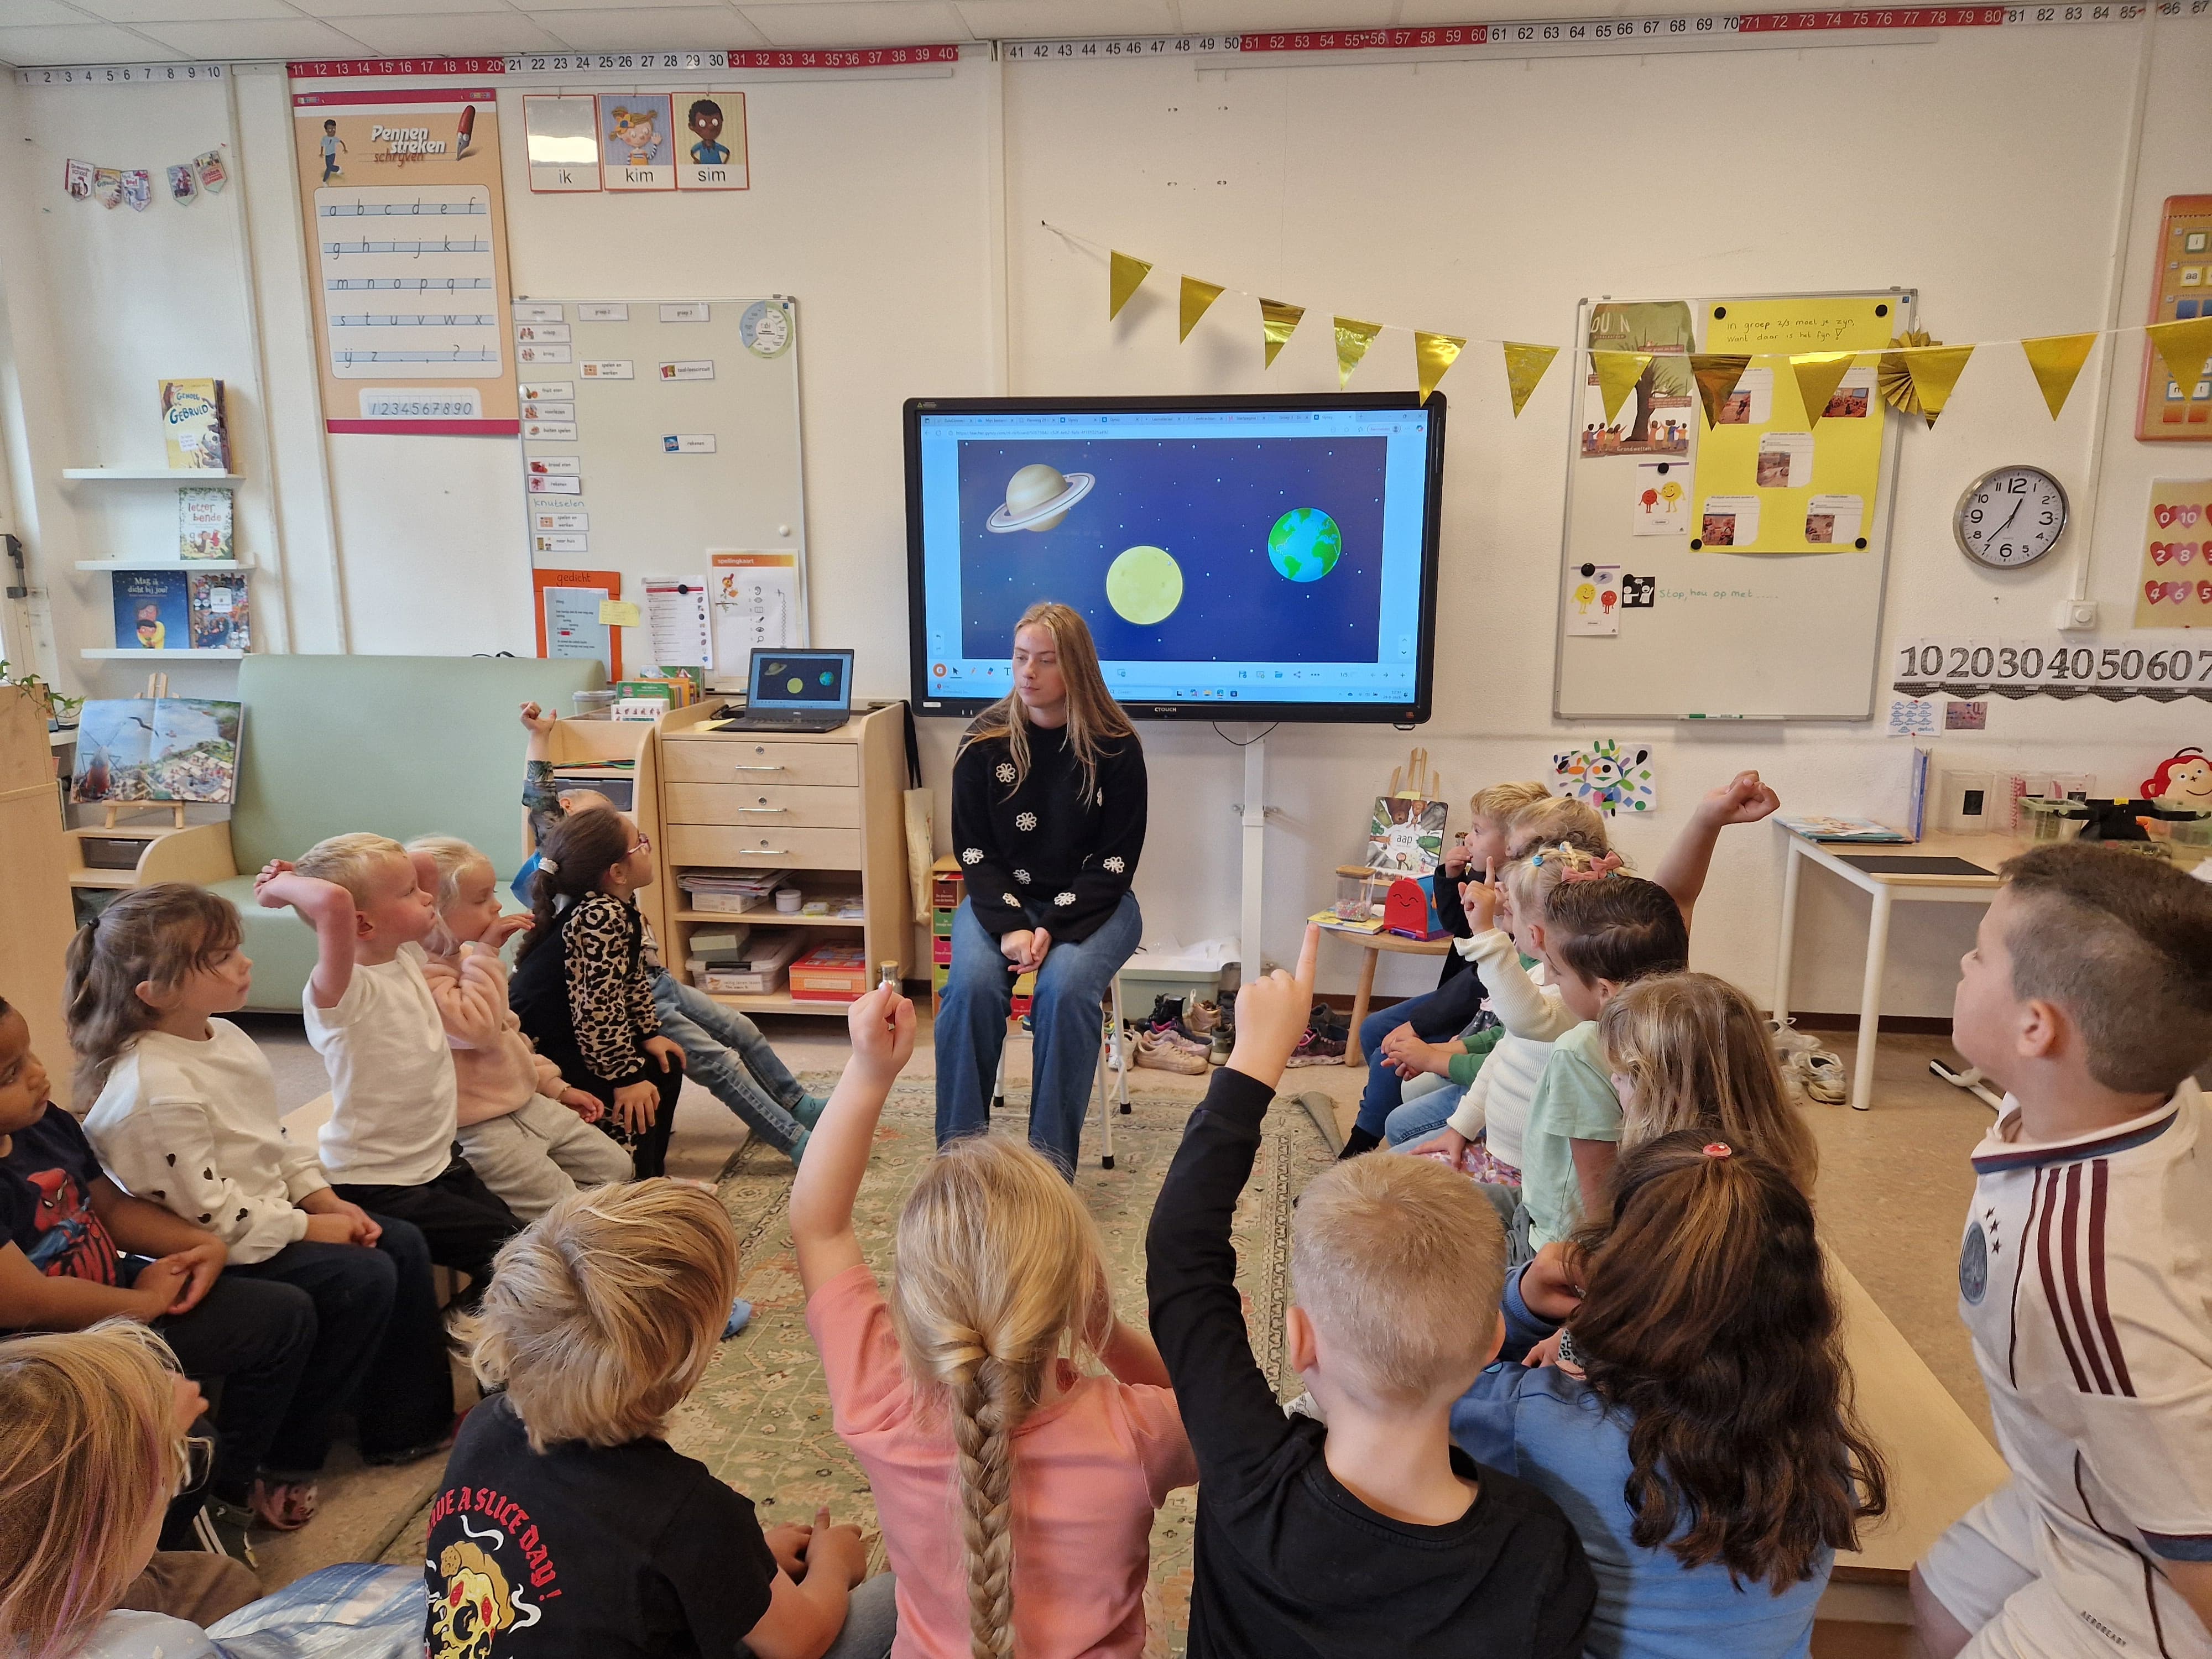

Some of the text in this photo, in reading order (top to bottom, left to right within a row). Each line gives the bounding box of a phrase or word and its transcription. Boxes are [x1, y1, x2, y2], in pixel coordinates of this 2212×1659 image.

[1245, 29, 1486, 49] 51 52 53 54 55 56 57 58 59 60
[24, 67, 221, 82] 1 2 3 4 5 6 7 8 9 10
[372, 125, 429, 142] Pennen
[390, 137, 445, 154] streken
[560, 170, 571, 184] ik
[625, 169, 653, 182] kim
[698, 168, 726, 182] sim
[330, 197, 476, 216] a b c d e f
[333, 243, 340, 259] g
[363, 236, 369, 252] h
[413, 238, 421, 258] j
[444, 235, 451, 252] k
[337, 278, 481, 295] m n o p q r
[341, 312, 482, 325] s t u v w x
[1744, 322, 1770, 333] groep
[372, 352, 377, 361] z
[1996, 482, 2001, 491] 11
[2008, 478, 2027, 493] 12
[2033, 483, 2036, 492] 1
[533, 499, 585, 507] knutselen
[1978, 494, 1989, 503] 10
[2042, 496, 2050, 504] 2
[1971, 509, 1983, 523] 9
[2038, 512, 2053, 525] 3
[2160, 512, 2170, 523] 0
[2180, 512, 2197, 523] 10
[2000, 544, 2012, 557] 6
[2156, 550, 2166, 561] 2
[2180, 550, 2190, 561] 8
[557, 573, 591, 587] gedicht
[1659, 589, 1687, 602] Stop,
[1690, 588, 1707, 597] hou
[1714, 591, 1726, 599] op
[1731, 589, 1752, 598] met
[2151, 588, 2159, 599] 4
[2175, 588, 2184, 599] 6
[2201, 588, 2212, 599] 5
[1901, 645, 1943, 677] 10
[1946, 647, 1994, 678] 20
[1997, 648, 2043, 678] 30
[2047, 648, 2094, 679] 40
[2097, 649, 2144, 681] 50
[2146, 649, 2193, 681] 60
[1397, 835, 1412, 845] aap
[457, 1486, 471, 1511] A
[474, 1488, 529, 1534] SLICE
